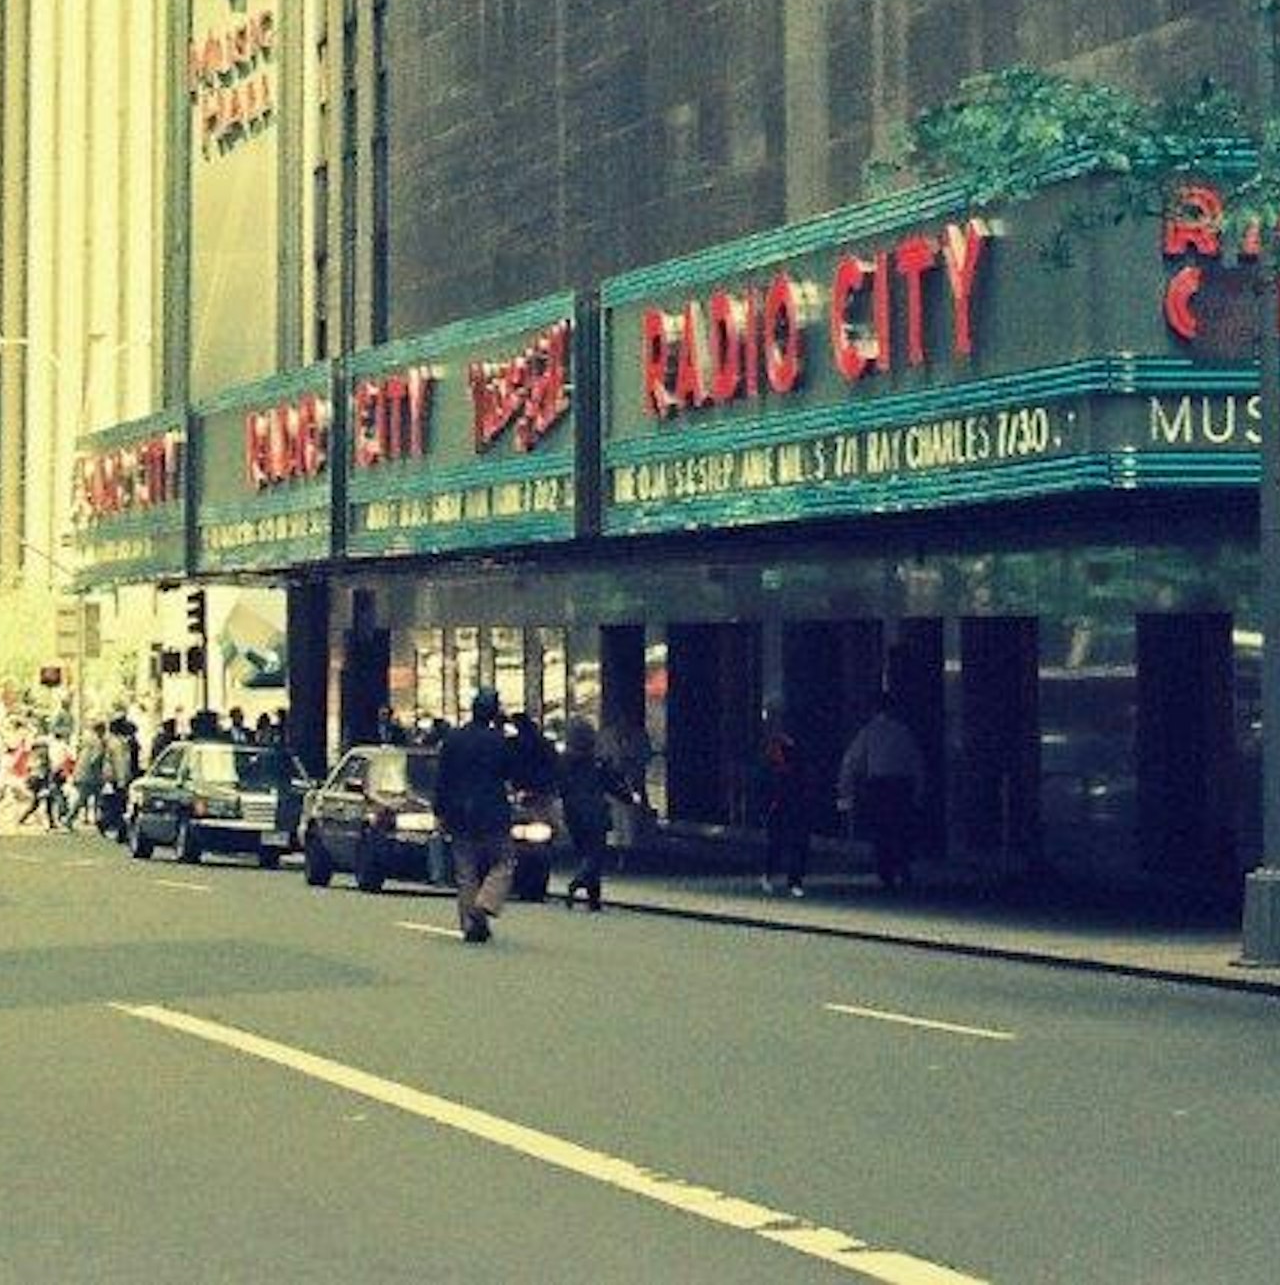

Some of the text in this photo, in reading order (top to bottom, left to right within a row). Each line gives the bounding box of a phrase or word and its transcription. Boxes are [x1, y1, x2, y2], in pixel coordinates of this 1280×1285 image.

[641, 270, 812, 414] RADIO
[829, 217, 996, 382] CITY
[905, 415, 992, 470] CHARLES
[997, 407, 1050, 459] 7/30
